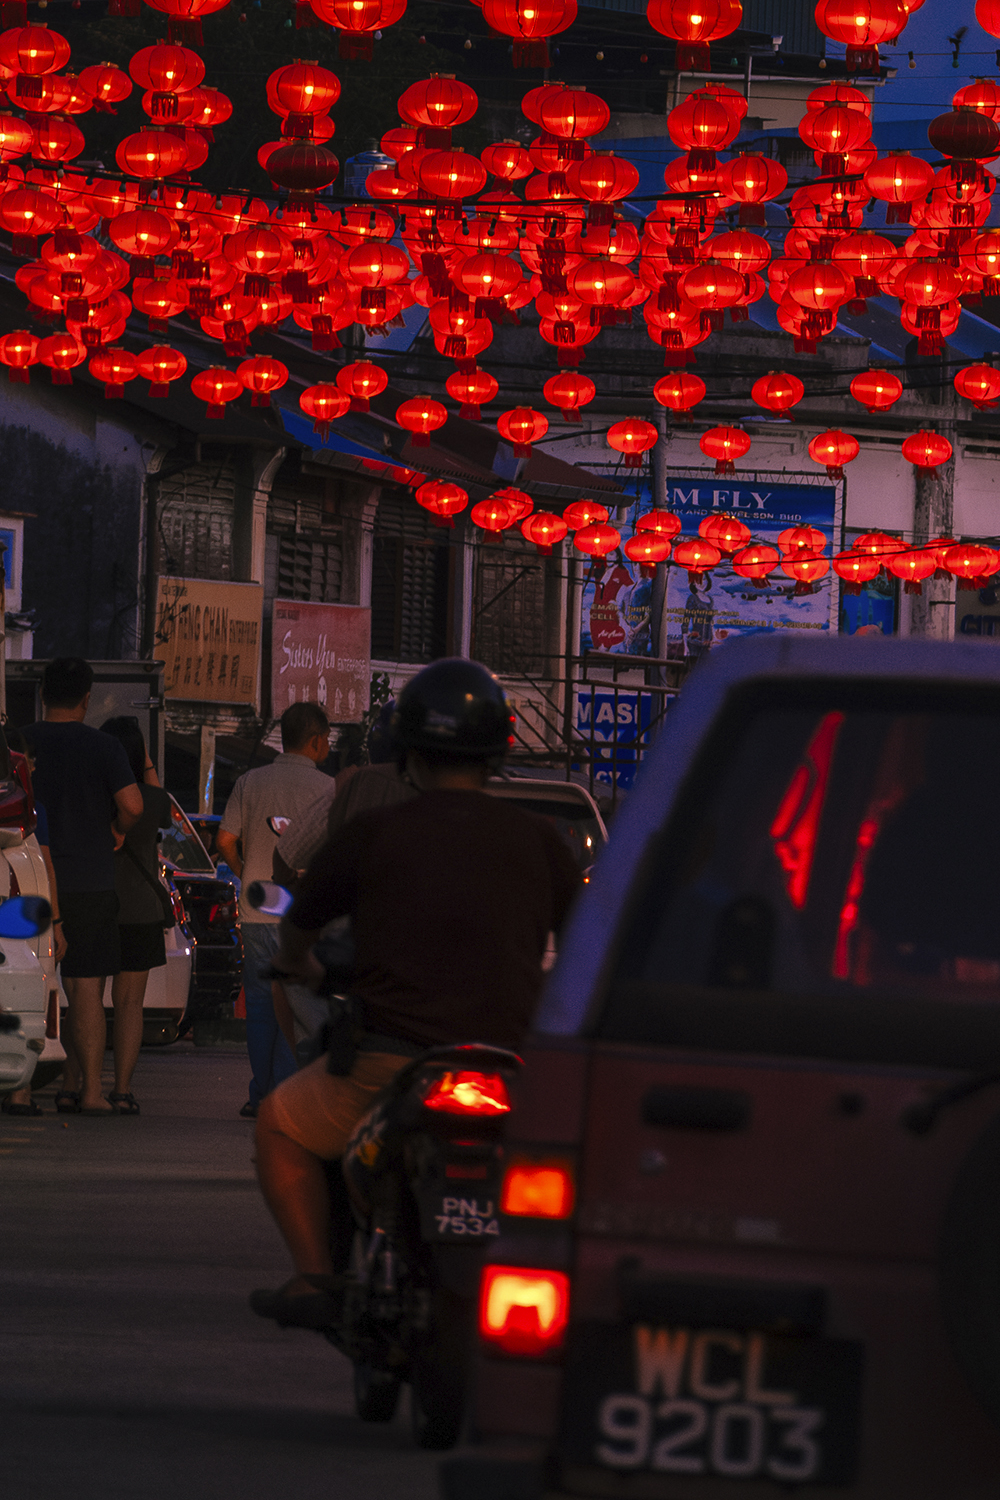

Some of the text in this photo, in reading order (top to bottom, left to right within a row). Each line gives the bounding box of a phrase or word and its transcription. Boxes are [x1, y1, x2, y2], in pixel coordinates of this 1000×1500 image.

[712, 489, 772, 510] FLY
[280, 629, 313, 675] Sisters
[441, 1196, 495, 1219] PNJ
[434, 1214, 502, 1237] 7534
[634, 1326, 799, 1402] WCL
[596, 1394, 827, 1478] 9203
